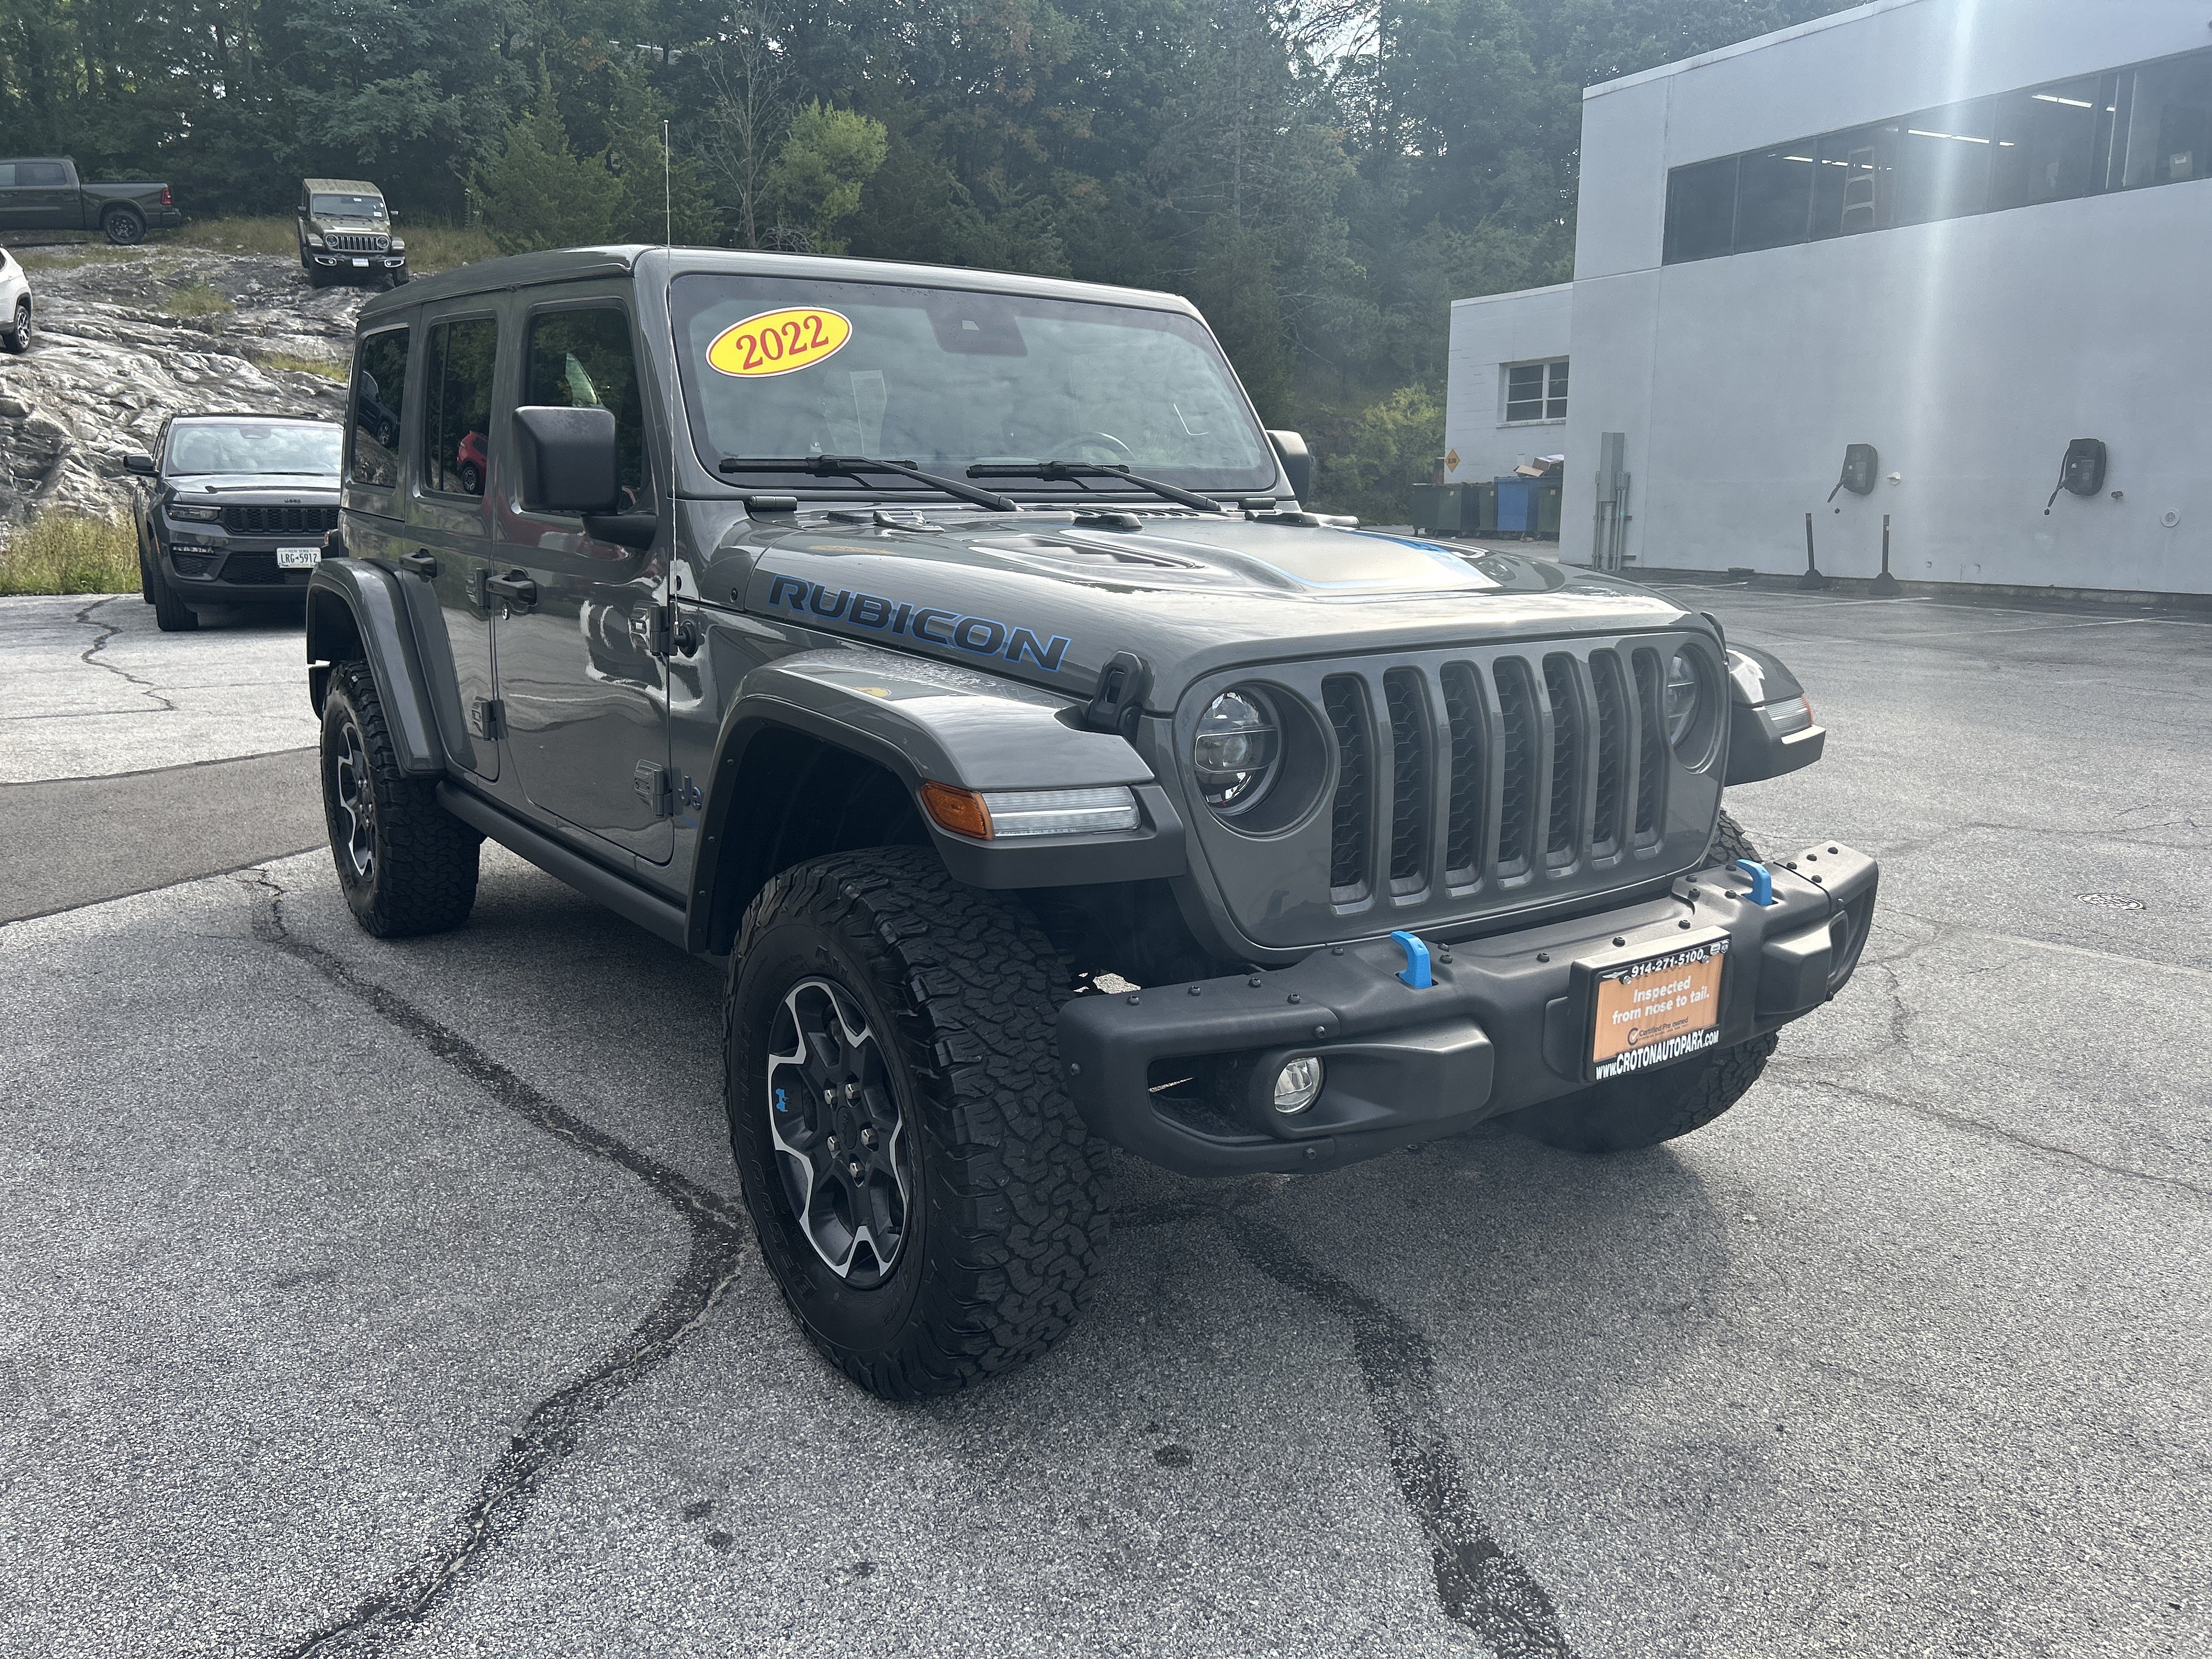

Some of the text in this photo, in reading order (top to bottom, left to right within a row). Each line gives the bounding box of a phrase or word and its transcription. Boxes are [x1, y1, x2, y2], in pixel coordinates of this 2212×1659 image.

[736, 315, 829, 370] 2022
[769, 574, 1071, 673] RUBICON
[678, 774, 702, 810] Je
[1631, 948, 1704, 977] 914-271-5100
[1612, 985, 1709, 1025] from nose to tail.
[1633, 975, 1691, 1003] Inspected
